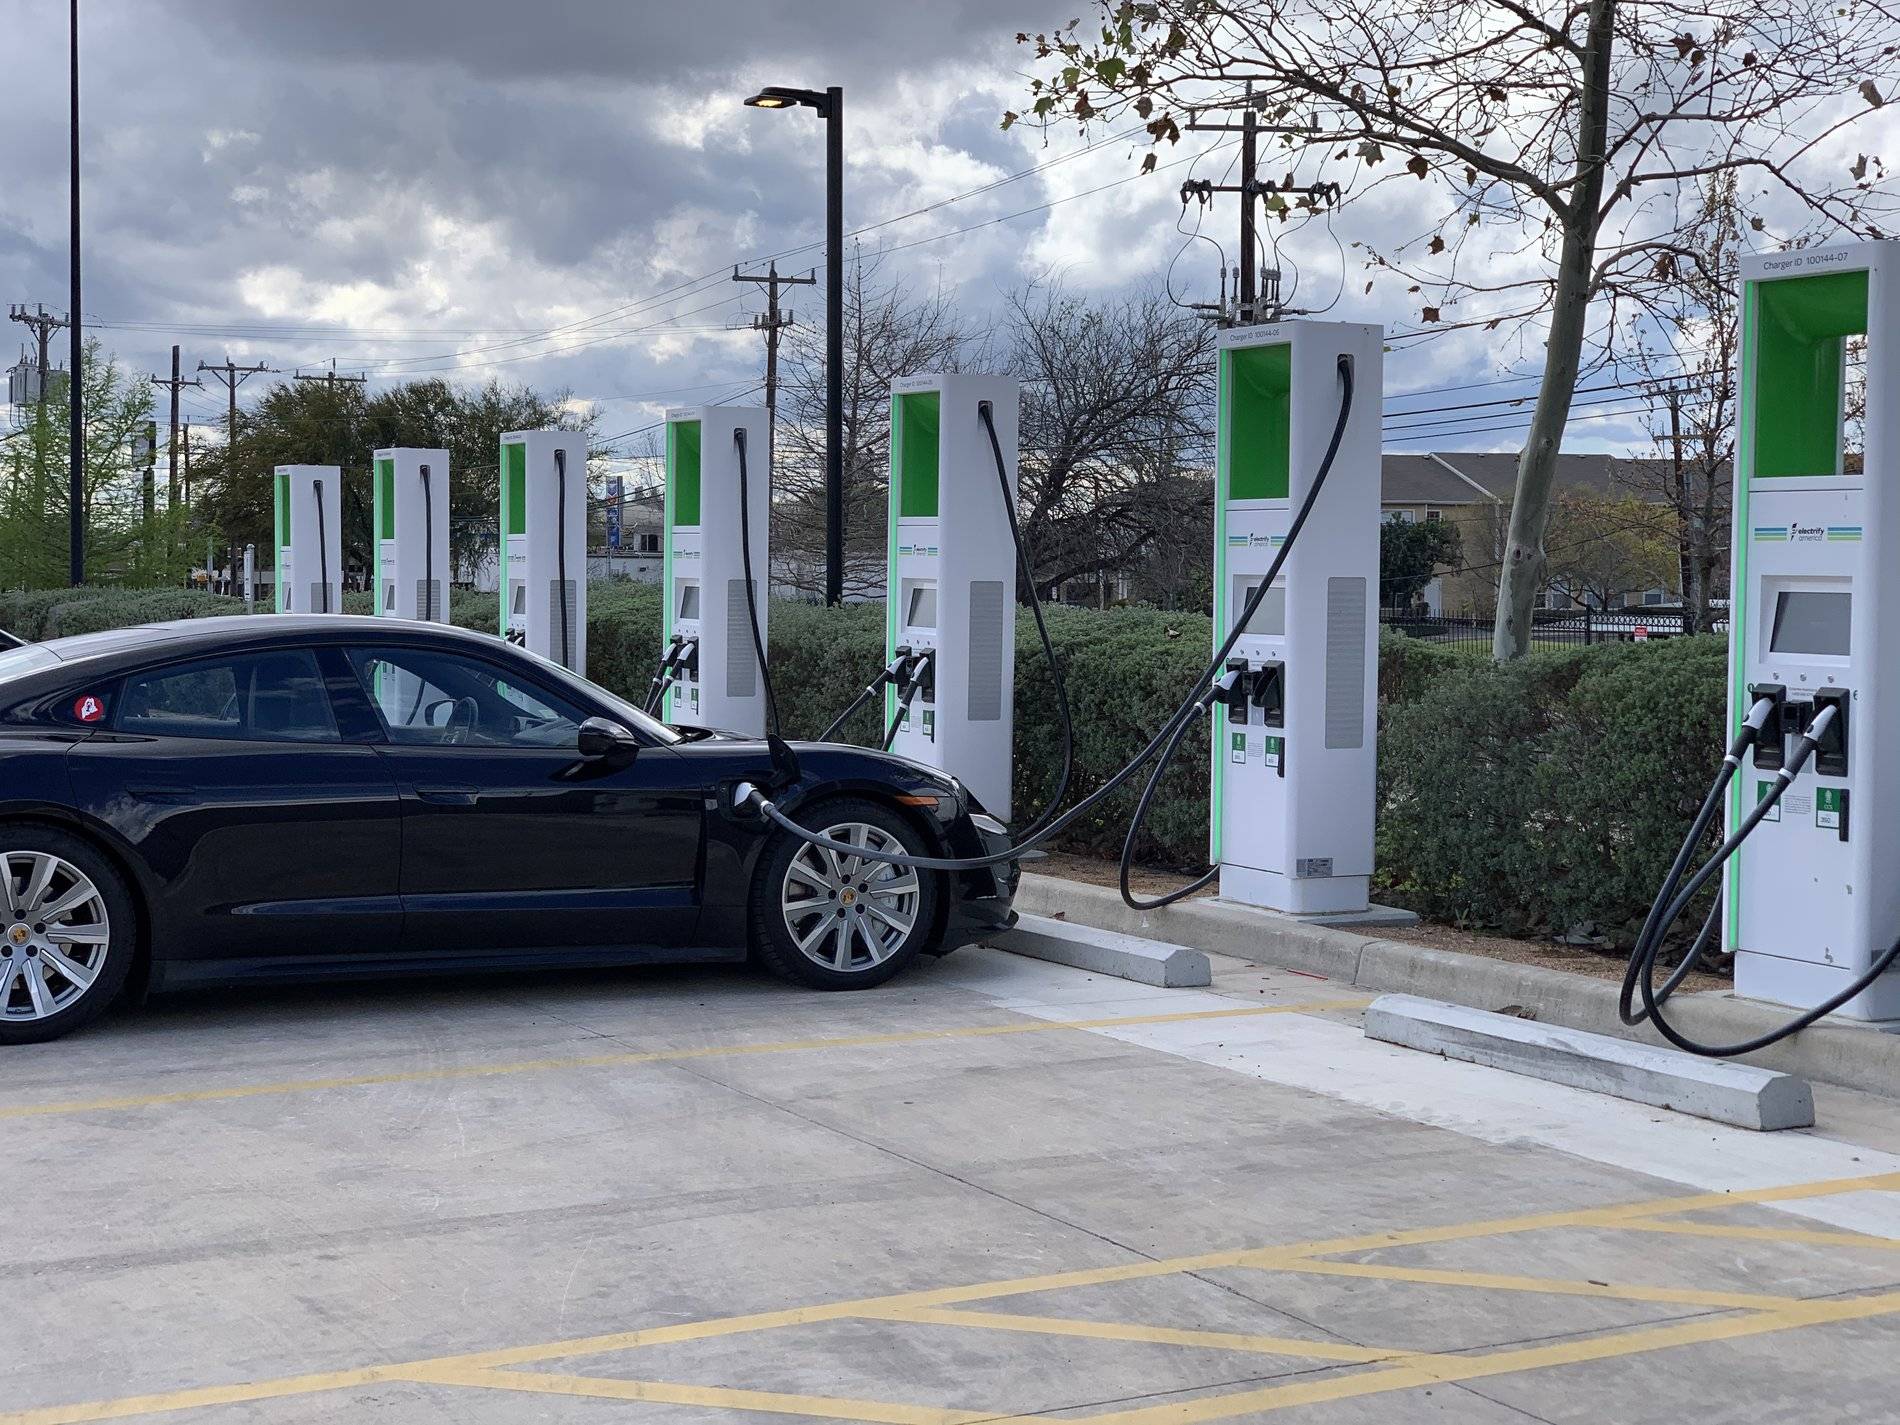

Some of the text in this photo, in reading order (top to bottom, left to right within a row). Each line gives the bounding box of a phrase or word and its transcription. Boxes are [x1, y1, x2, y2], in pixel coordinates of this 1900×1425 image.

[1763, 252, 1848, 270] Charger ID 100144-07
[1798, 527, 1824, 535] electrify
